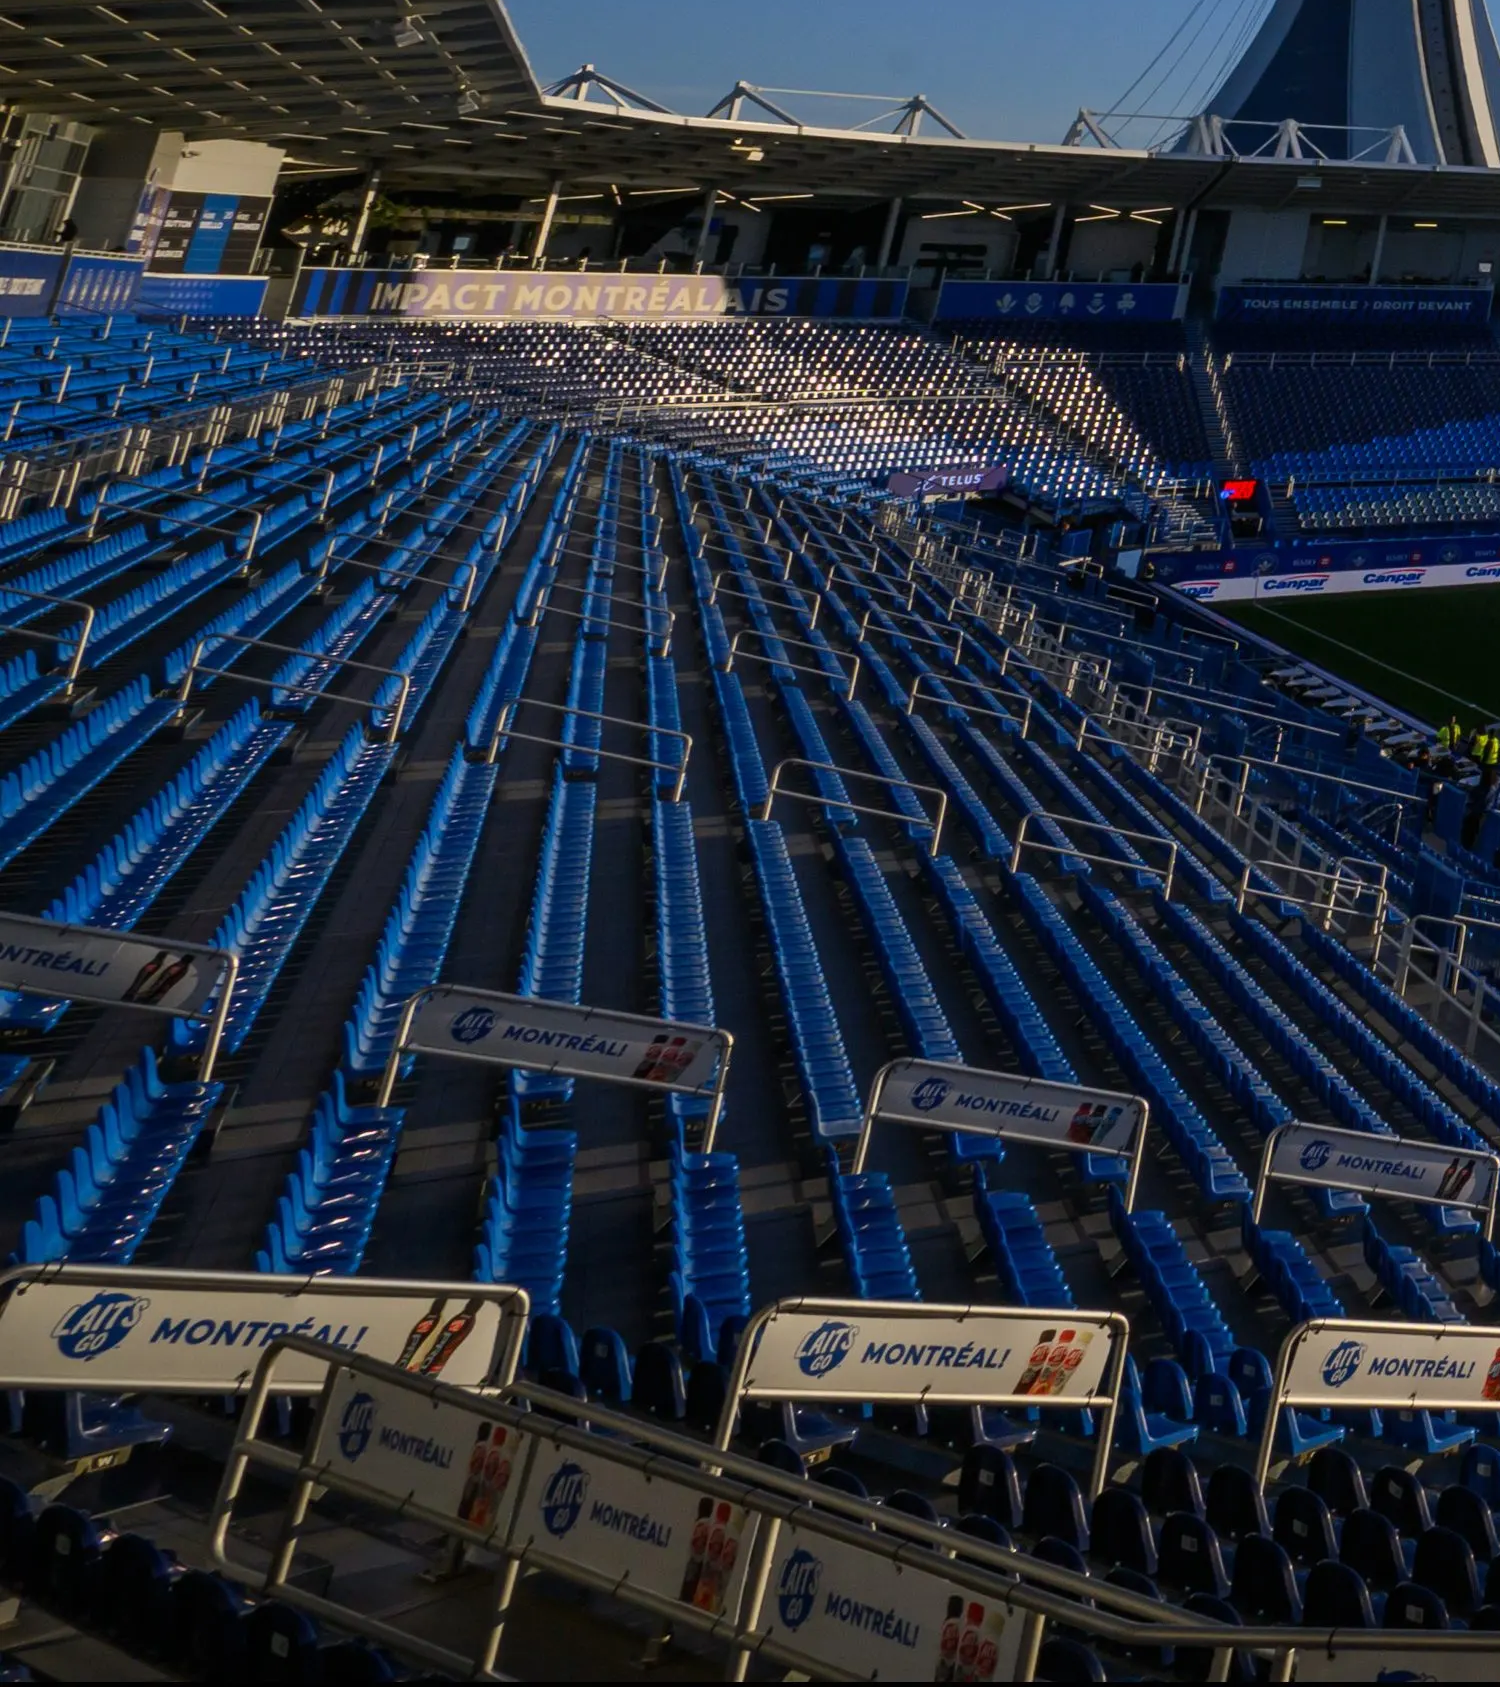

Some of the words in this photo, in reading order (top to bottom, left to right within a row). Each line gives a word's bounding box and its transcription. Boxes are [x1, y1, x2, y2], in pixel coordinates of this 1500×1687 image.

[370, 281, 508, 310] IMPACT
[514, 280, 790, 312] MONTRÉALAIS
[1242, 299, 1281, 309] TOUS
[1283, 299, 1359, 310] ENSEMBLE
[1372, 301, 1416, 310] DROIT
[1418, 301, 1472, 311] DEVANT
[941, 473, 983, 487] TELUS
[1263, 577, 1329, 591] Canpar
[1363, 571, 1427, 585] Canpar
[502, 1025, 629, 1057] MONTRÉAL!
[954, 1093, 1060, 1122] MONTRÉAL!
[1336, 1154, 1427, 1179] MONTRÉAL!
[52, 1293, 150, 1338] LAIT'S
[150, 1315, 369, 1353] MONTRÉAL!
[797, 1323, 861, 1359] LAIT'S
[861, 1341, 1012, 1370] MONTRÉAL!
[1321, 1343, 1367, 1371] LAIT'S
[1368, 1356, 1476, 1379] MONTRÉAL!
[380, 1424, 454, 1471] MONTRÉAL!
[590, 1502, 671, 1549] MONTRÉAL!
[824, 1590, 921, 1649] MONTRÉAL!
